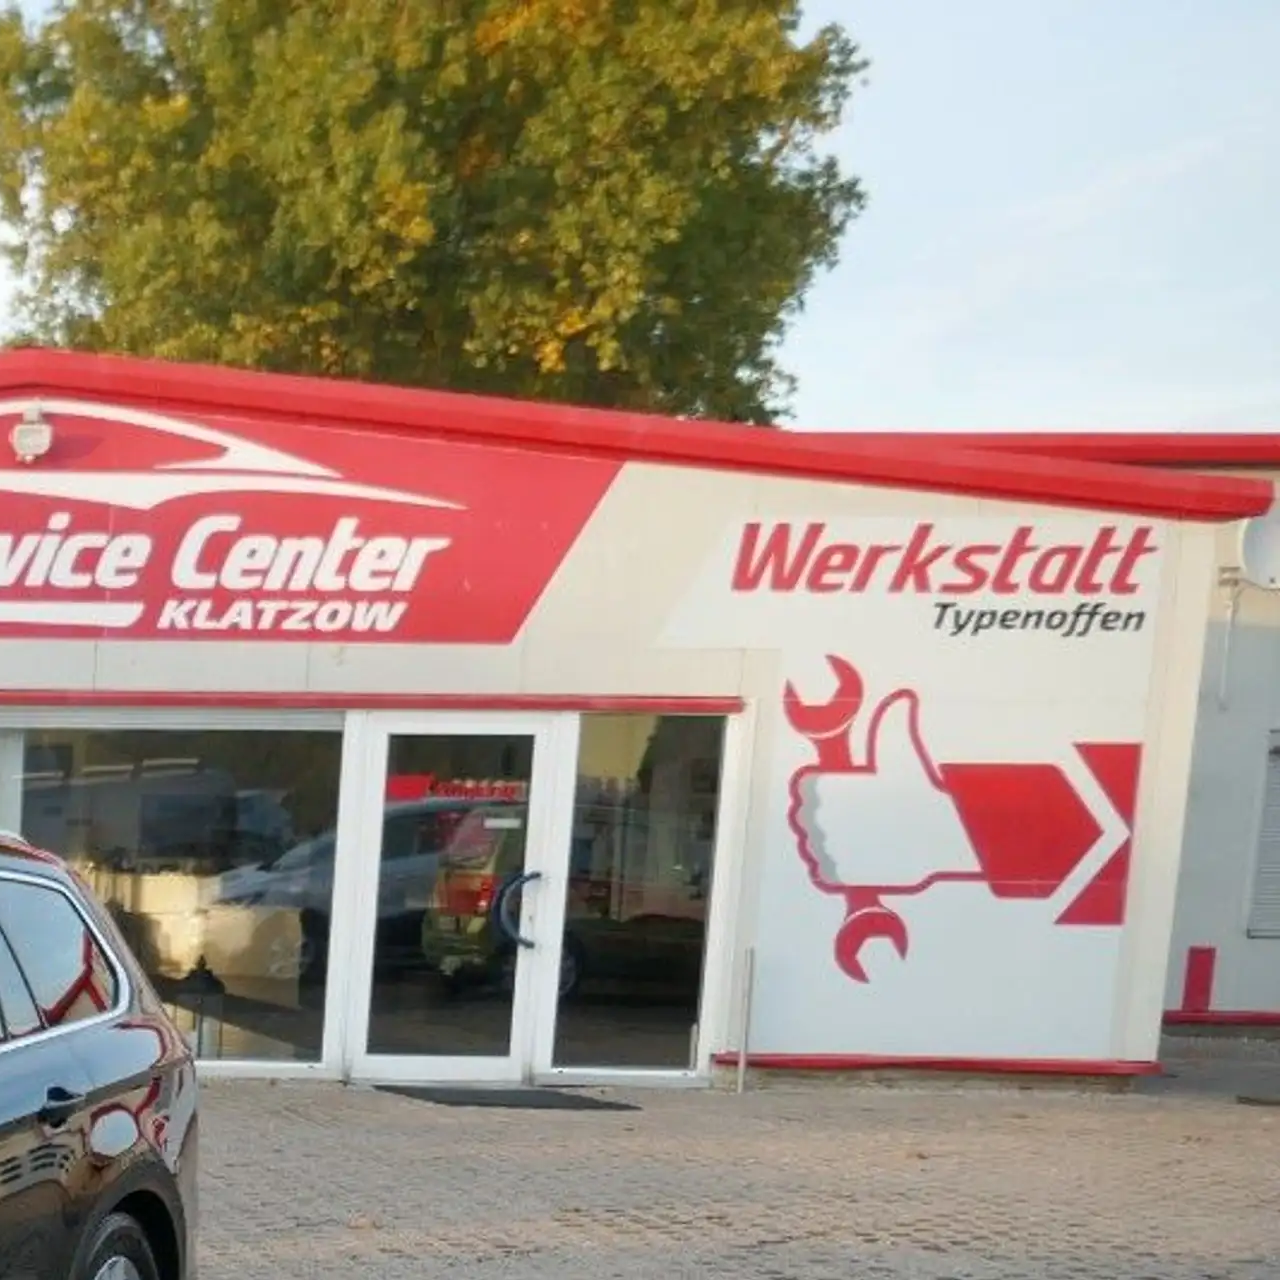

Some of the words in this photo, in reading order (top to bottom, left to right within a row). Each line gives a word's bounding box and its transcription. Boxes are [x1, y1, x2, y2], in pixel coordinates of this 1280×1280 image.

[171, 514, 452, 593] Center
[731, 521, 1158, 595] Werkstatt
[156, 599, 409, 633] KLATZOW
[933, 601, 1146, 637] Typenoffen
